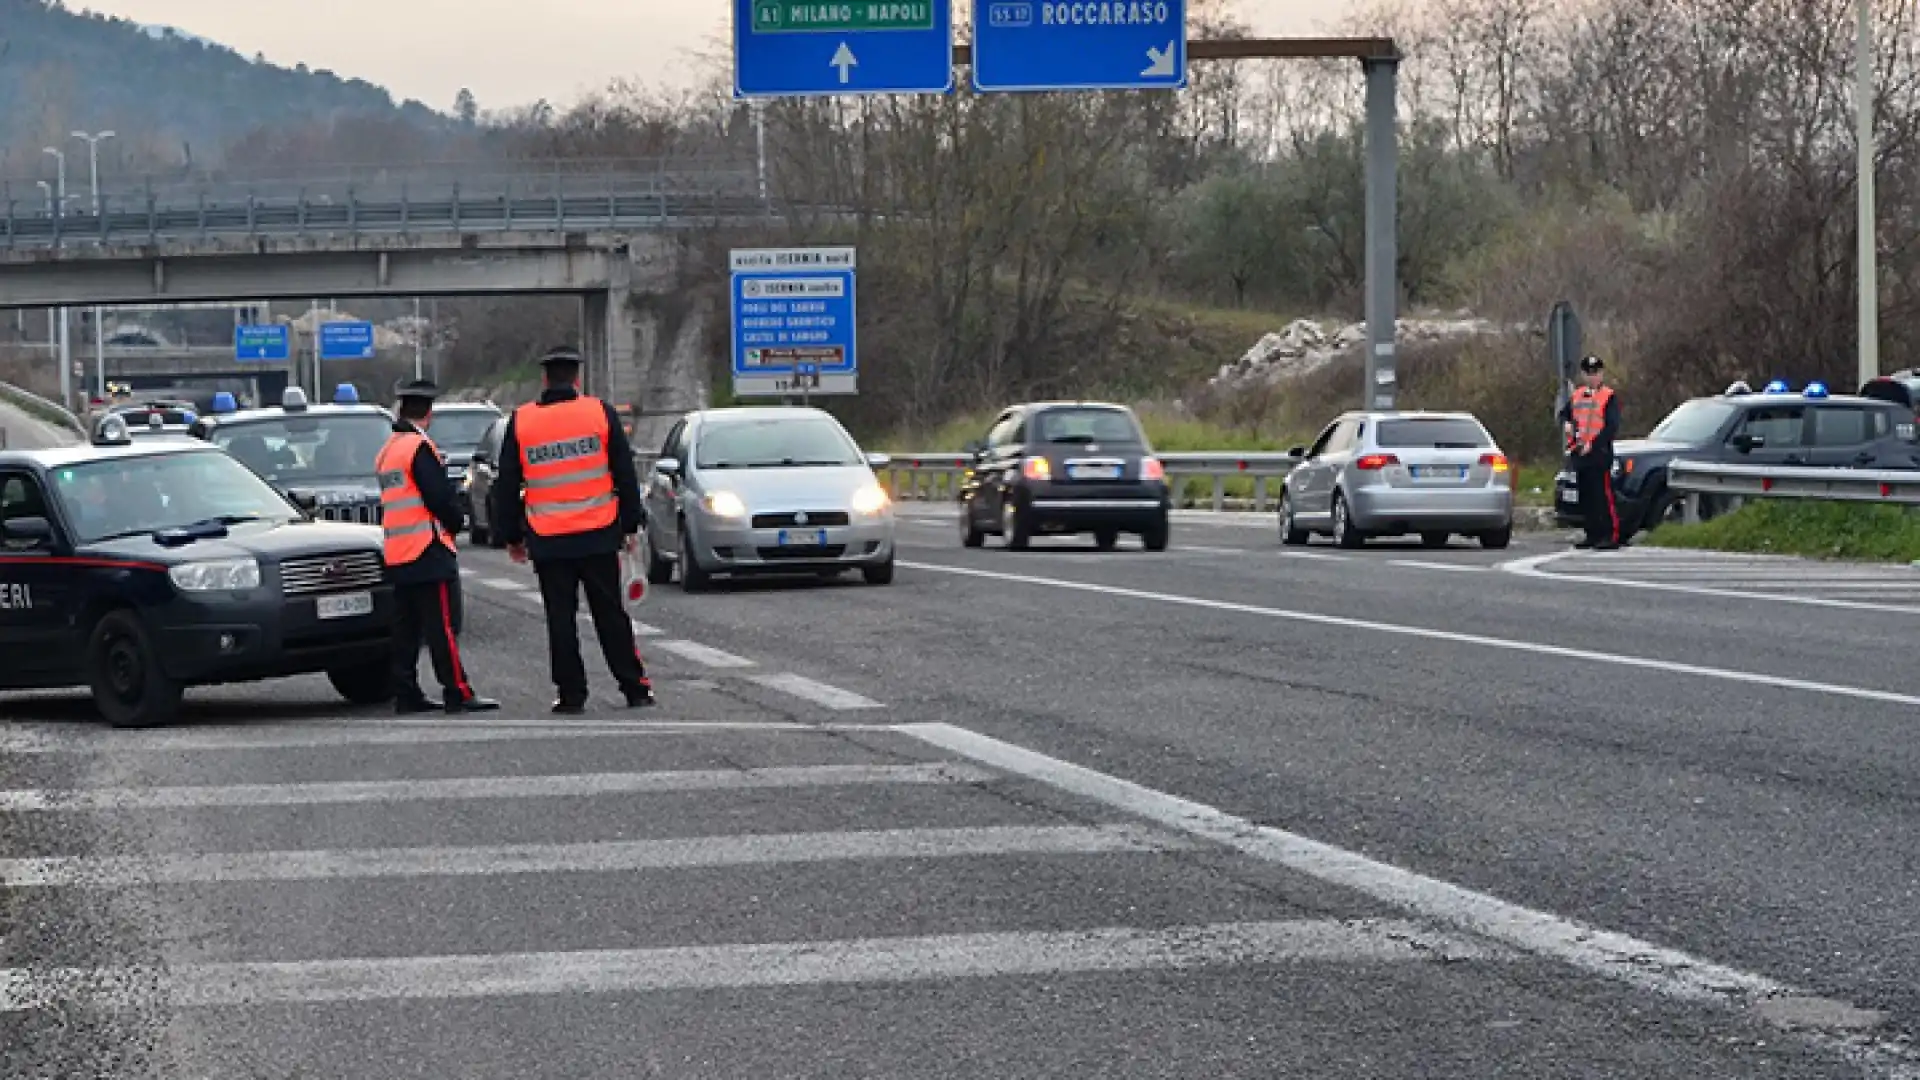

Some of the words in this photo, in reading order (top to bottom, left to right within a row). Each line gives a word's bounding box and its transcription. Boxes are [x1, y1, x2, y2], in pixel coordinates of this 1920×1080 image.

[791, 4, 851, 22] MILANO
[868, 3, 925, 21] NAPOLI
[1042, 1, 1168, 25] ROCCARASO
